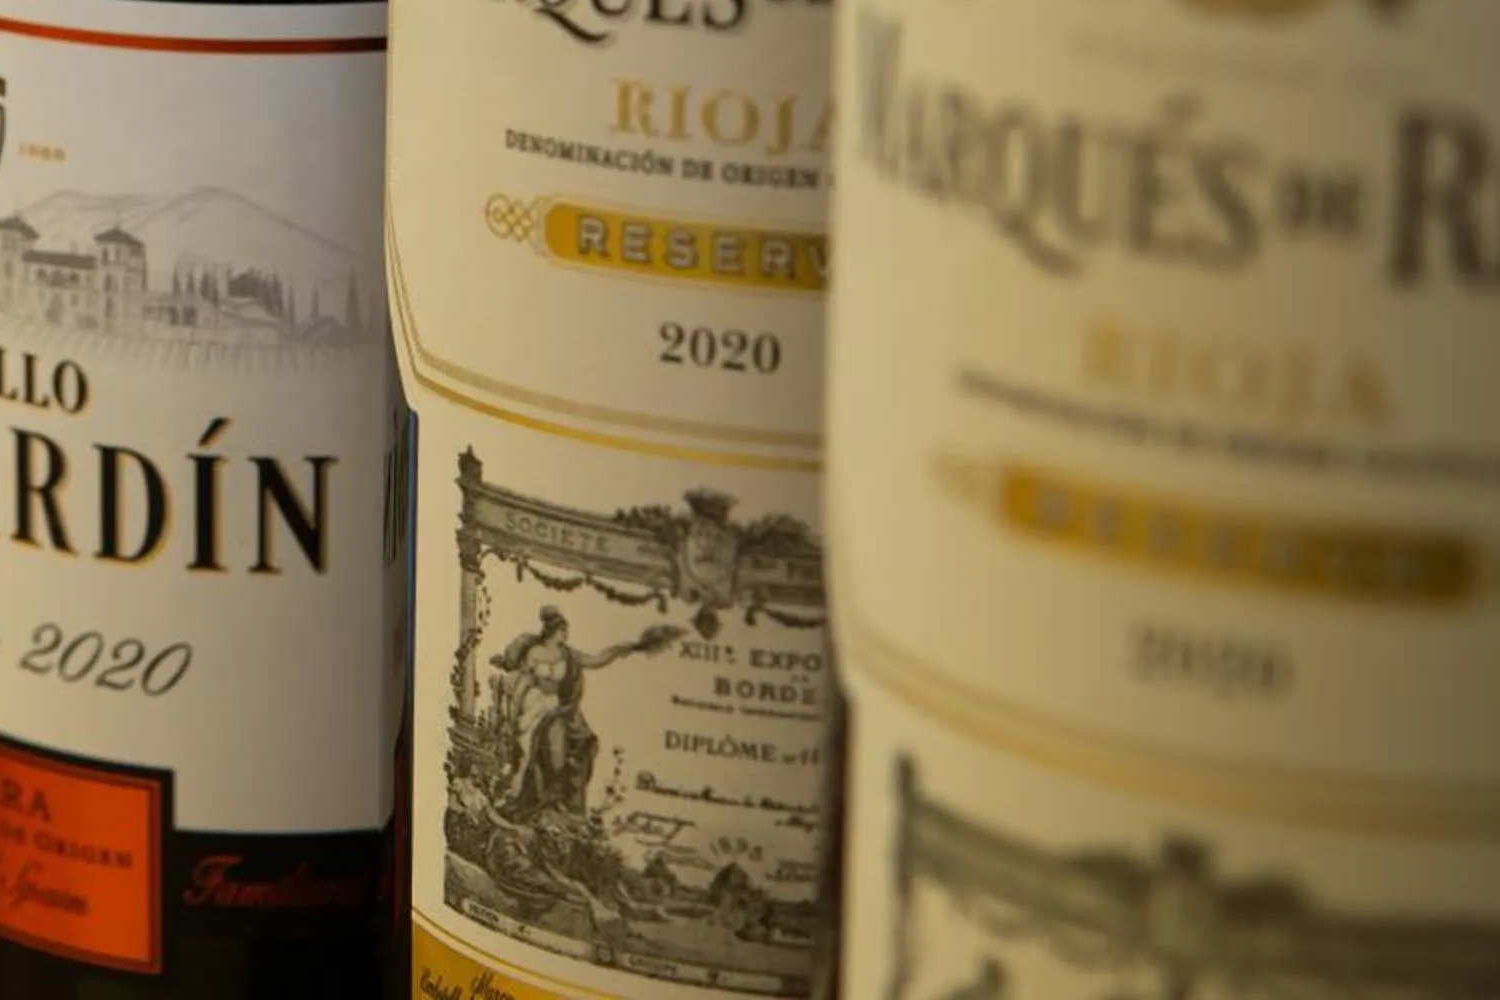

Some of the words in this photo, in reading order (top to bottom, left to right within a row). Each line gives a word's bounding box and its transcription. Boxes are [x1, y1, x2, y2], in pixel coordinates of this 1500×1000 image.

[504, 128, 673, 178] DENOMINACIÓN
[681, 156, 713, 182] DE
[720, 162, 818, 190] ORIGEN
[658, 321, 782, 375] 2020
[19, 623, 193, 696] 2020
